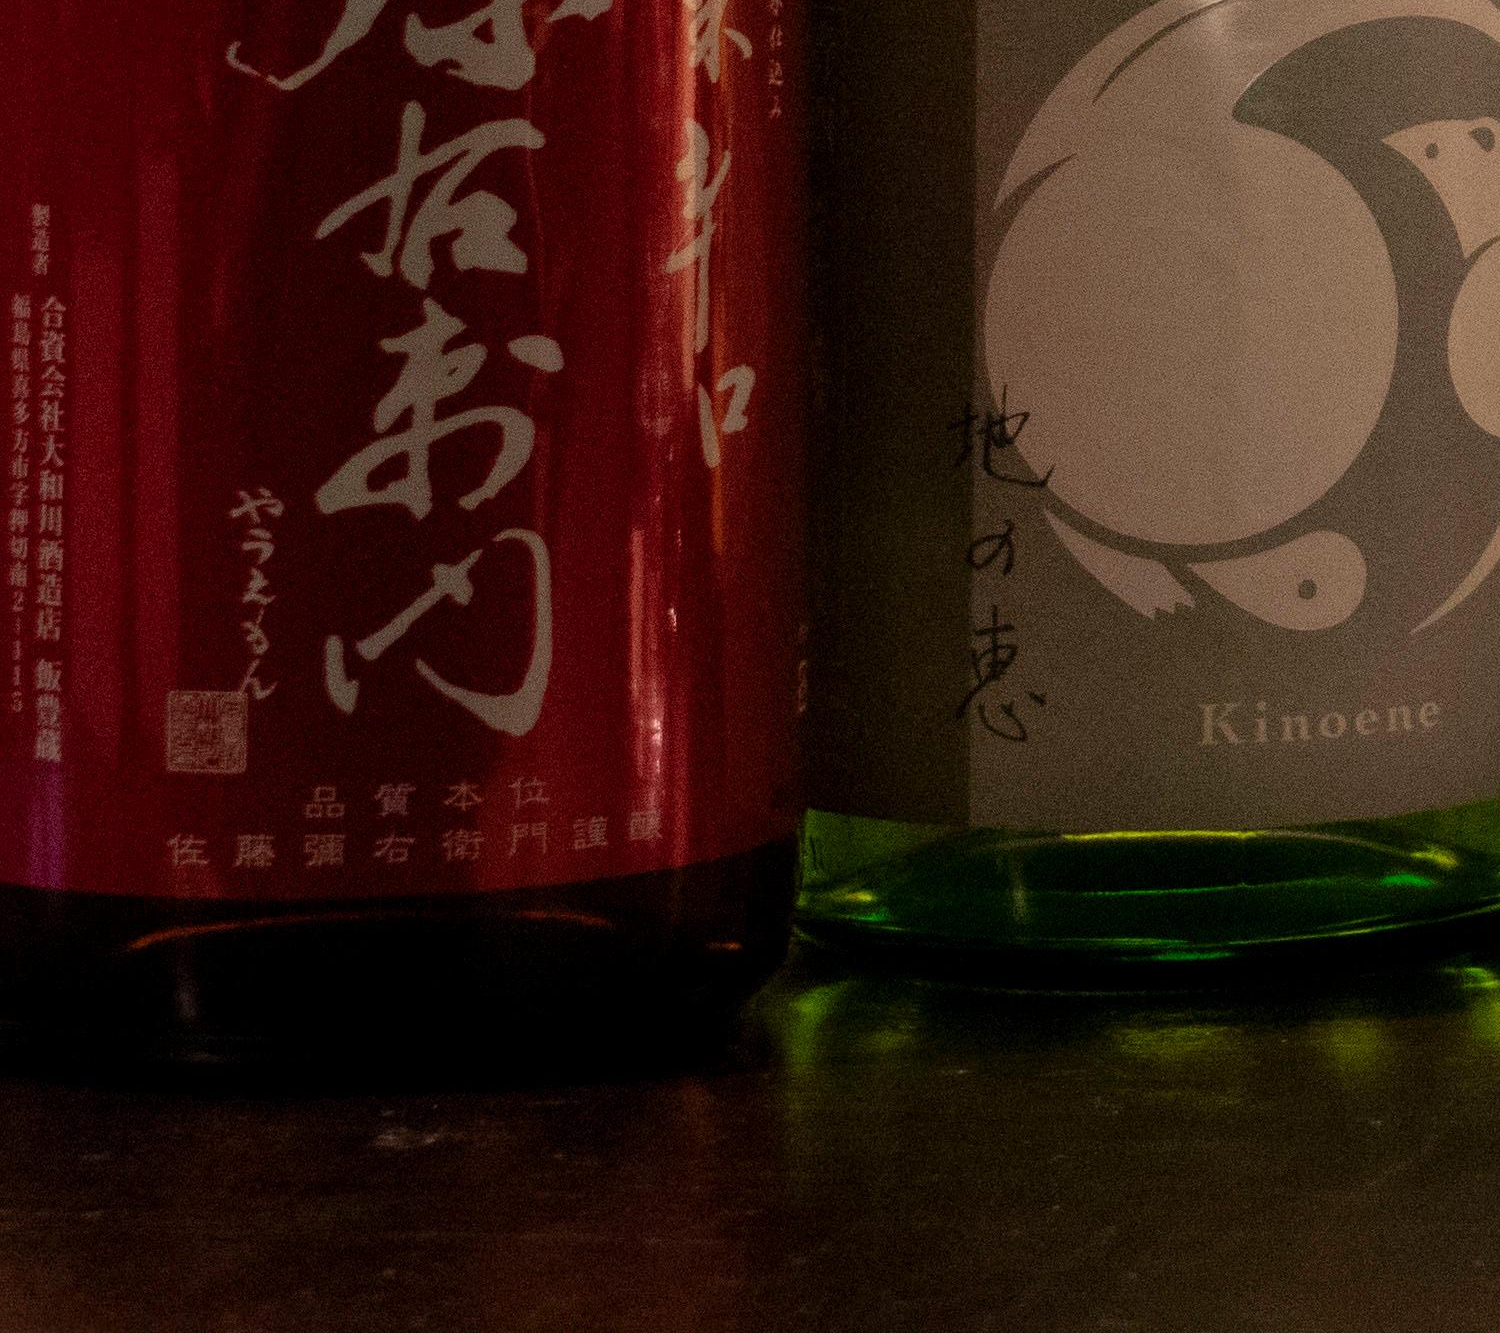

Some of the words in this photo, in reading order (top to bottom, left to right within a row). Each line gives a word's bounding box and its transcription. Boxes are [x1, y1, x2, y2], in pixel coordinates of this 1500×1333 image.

[1200, 699, 1442, 746] Kinoene
[304, 775, 550, 819] 品質本位
